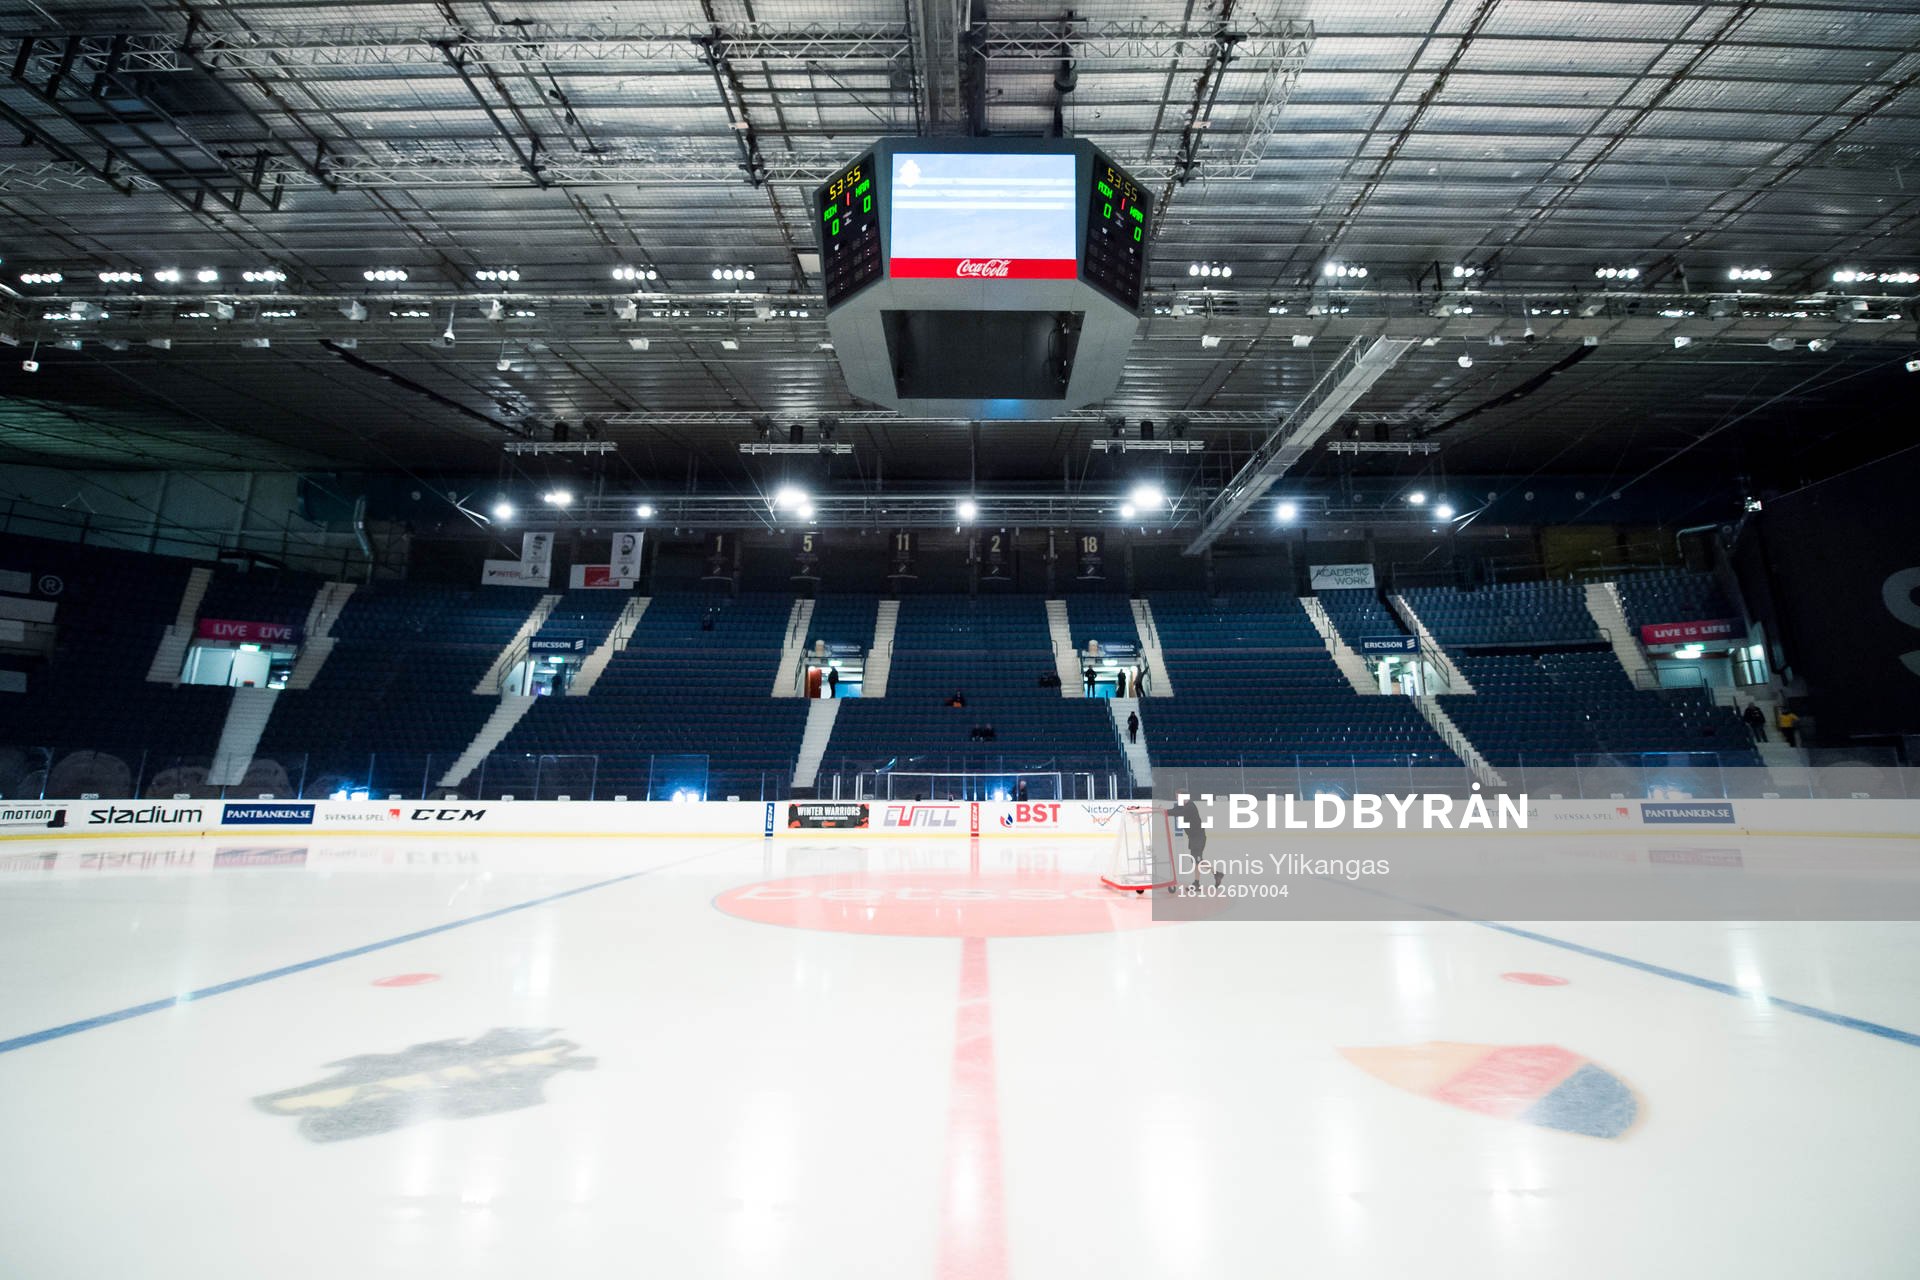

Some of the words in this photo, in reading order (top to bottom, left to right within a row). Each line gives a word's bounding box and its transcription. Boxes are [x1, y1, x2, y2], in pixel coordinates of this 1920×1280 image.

[829, 165, 861, 201] 53:55
[1107, 167, 1138, 202] 53:55
[863, 194, 872, 213] 0
[1103, 203, 1112, 219] 0
[831, 217, 840, 236] 0
[1133, 226, 1142, 242] 0
[956, 259, 1012, 277] Coca-Cola
[715, 535, 723, 553] 1
[802, 535, 813, 553] 5
[896, 533, 910, 551] 11
[991, 535, 1001, 553] 2
[1081, 536, 1098, 553] 18
[1316, 567, 1369, 577] ACADEMIC
[214, 623, 248, 637] LIVE
[259, 626, 292, 640] LIVE
[1654, 628, 1681, 638] LIVE
[1684, 627, 1697, 635] IS
[1700, 624, 1731, 634] LIFE!
[532, 641, 571, 649] ERICSSON
[1364, 641, 1403, 649] ERICSSON
[2, 809, 52, 820] MOTION
[88, 806, 203, 824] stadium
[226, 810, 311, 819] PANTBANKEN.SE
[324, 813, 363, 821] SVENSKA
[411, 809, 487, 821] CCM
[797, 806, 823, 816] WINTER
[824, 806, 861, 816] WARRIORS
[1016, 804, 1060, 823] BST
[1644, 809, 1731, 818] PANTBANKEN.SE
